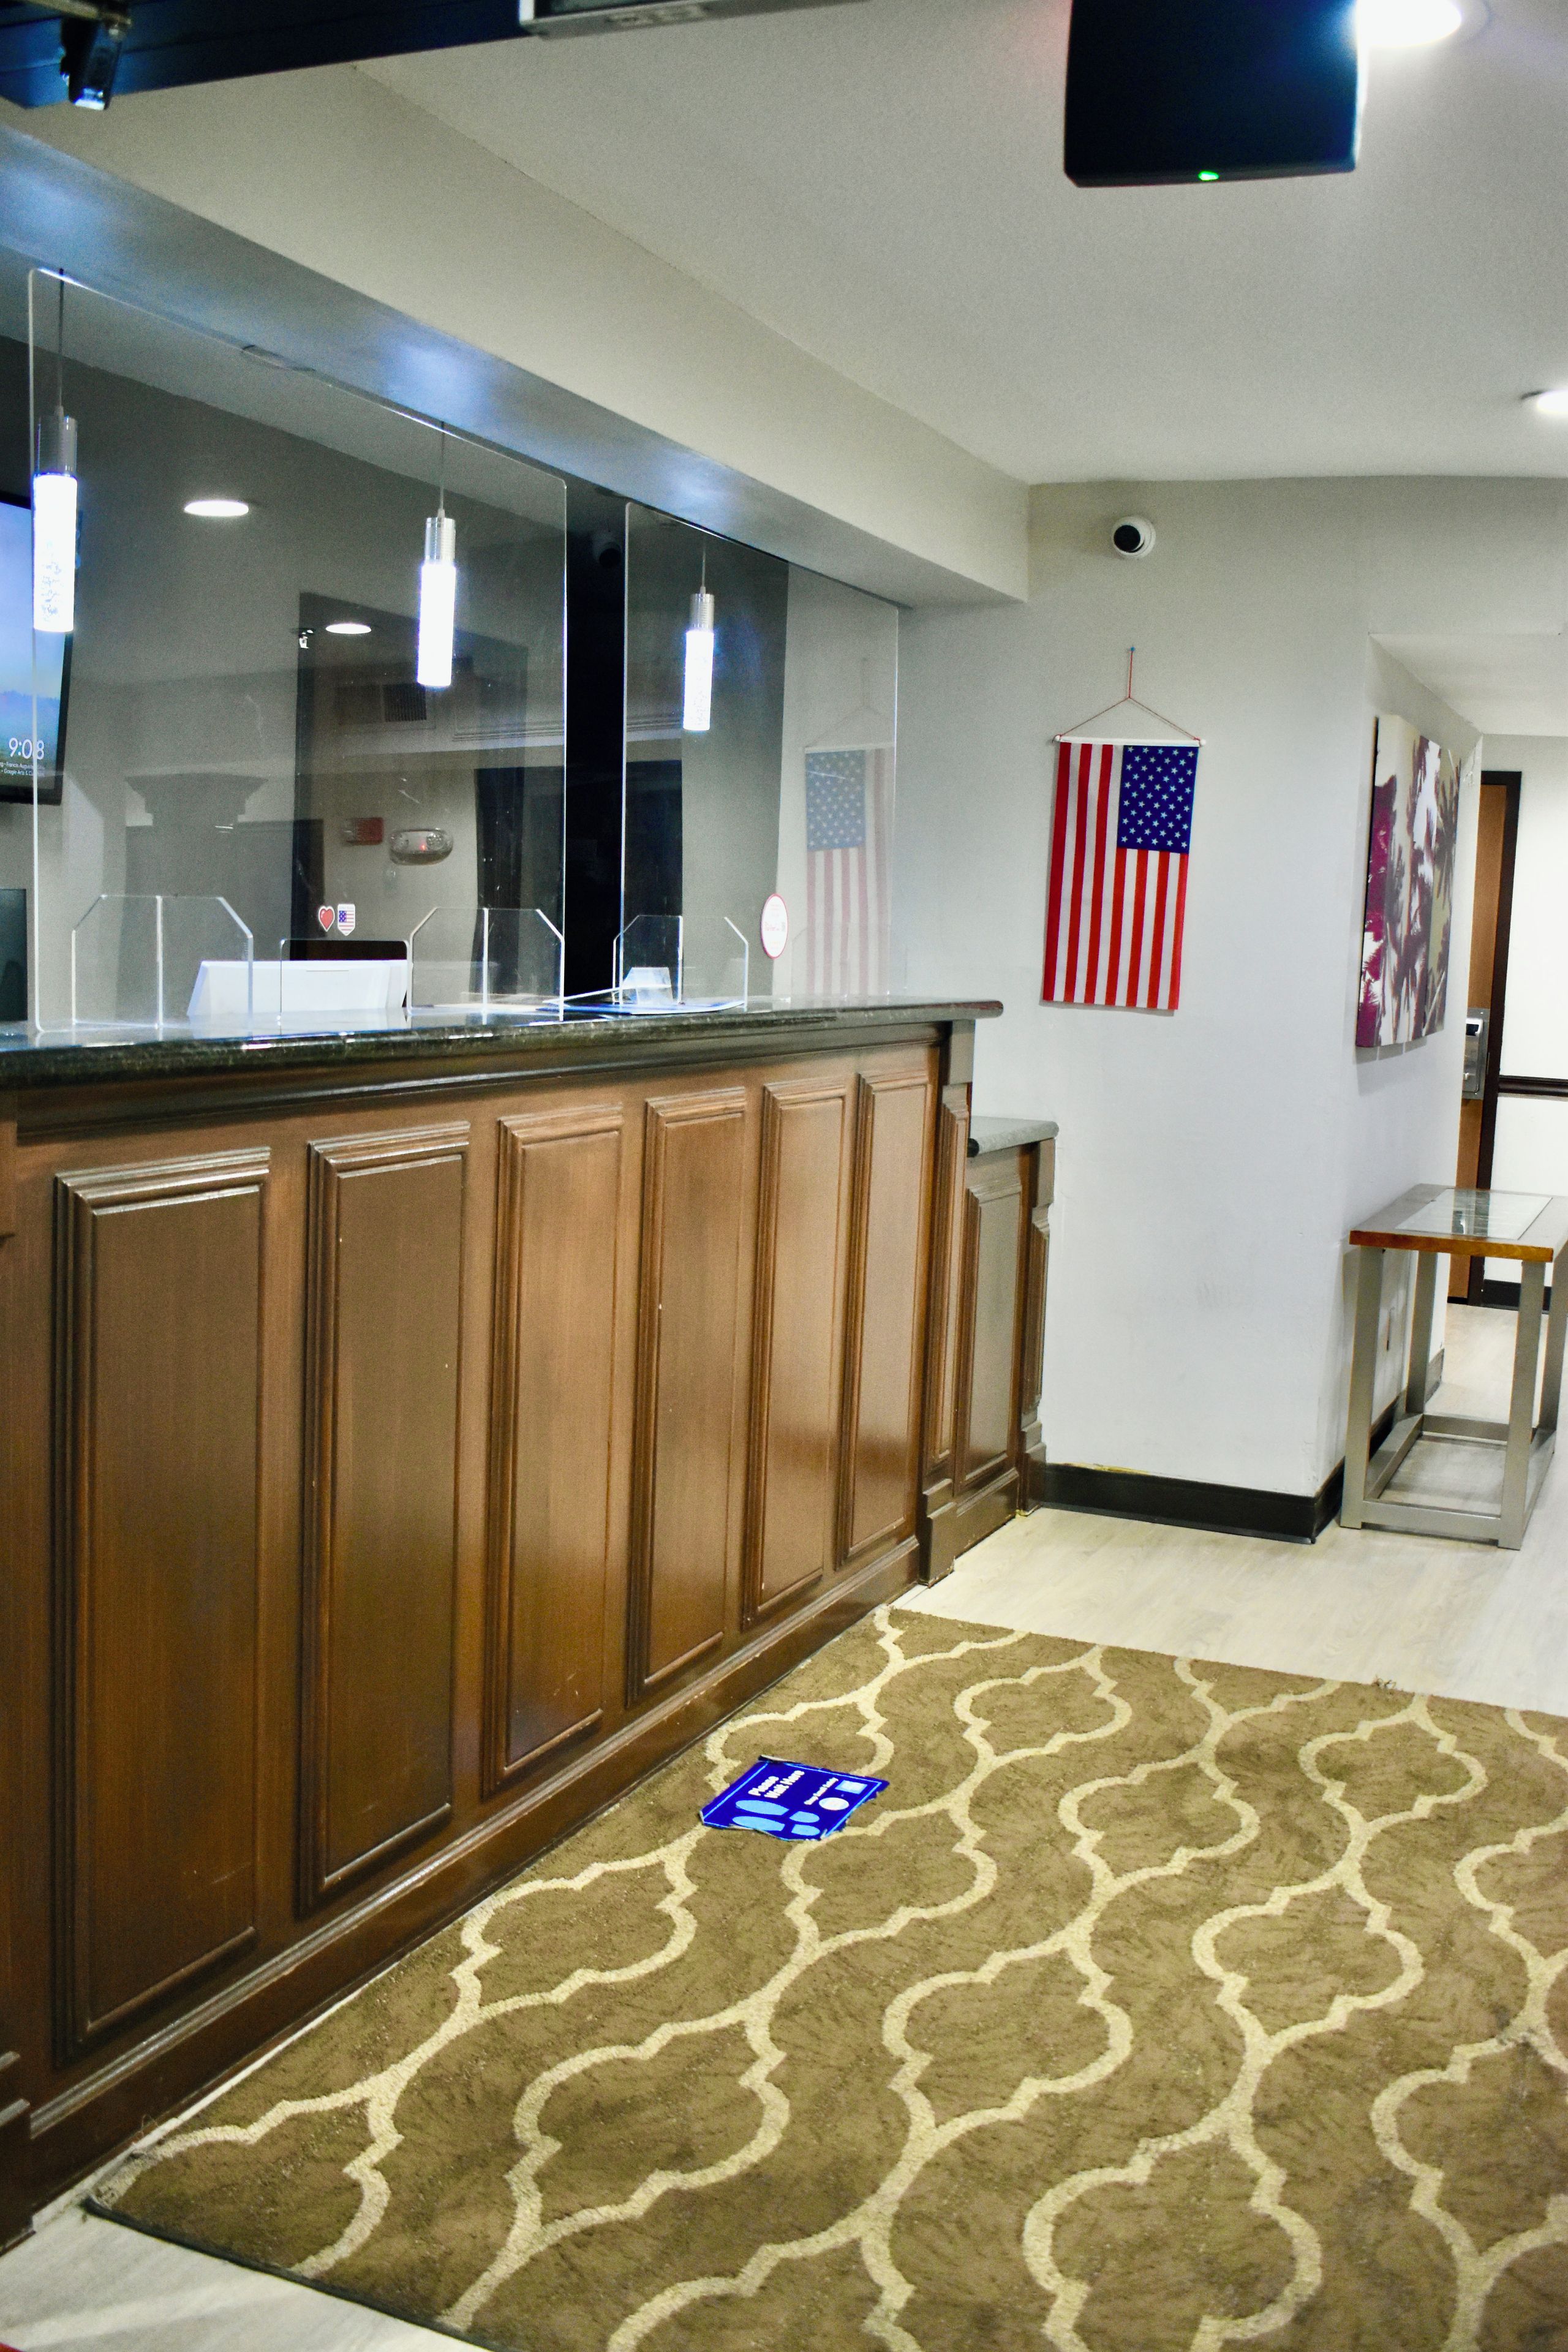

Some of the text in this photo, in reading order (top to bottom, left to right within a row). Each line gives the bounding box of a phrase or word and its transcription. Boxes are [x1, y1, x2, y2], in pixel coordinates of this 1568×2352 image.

[9, 737, 45, 760] 9:08
[748, 1776, 779, 1796] Please
[764, 1770, 805, 1798] Wait Here
